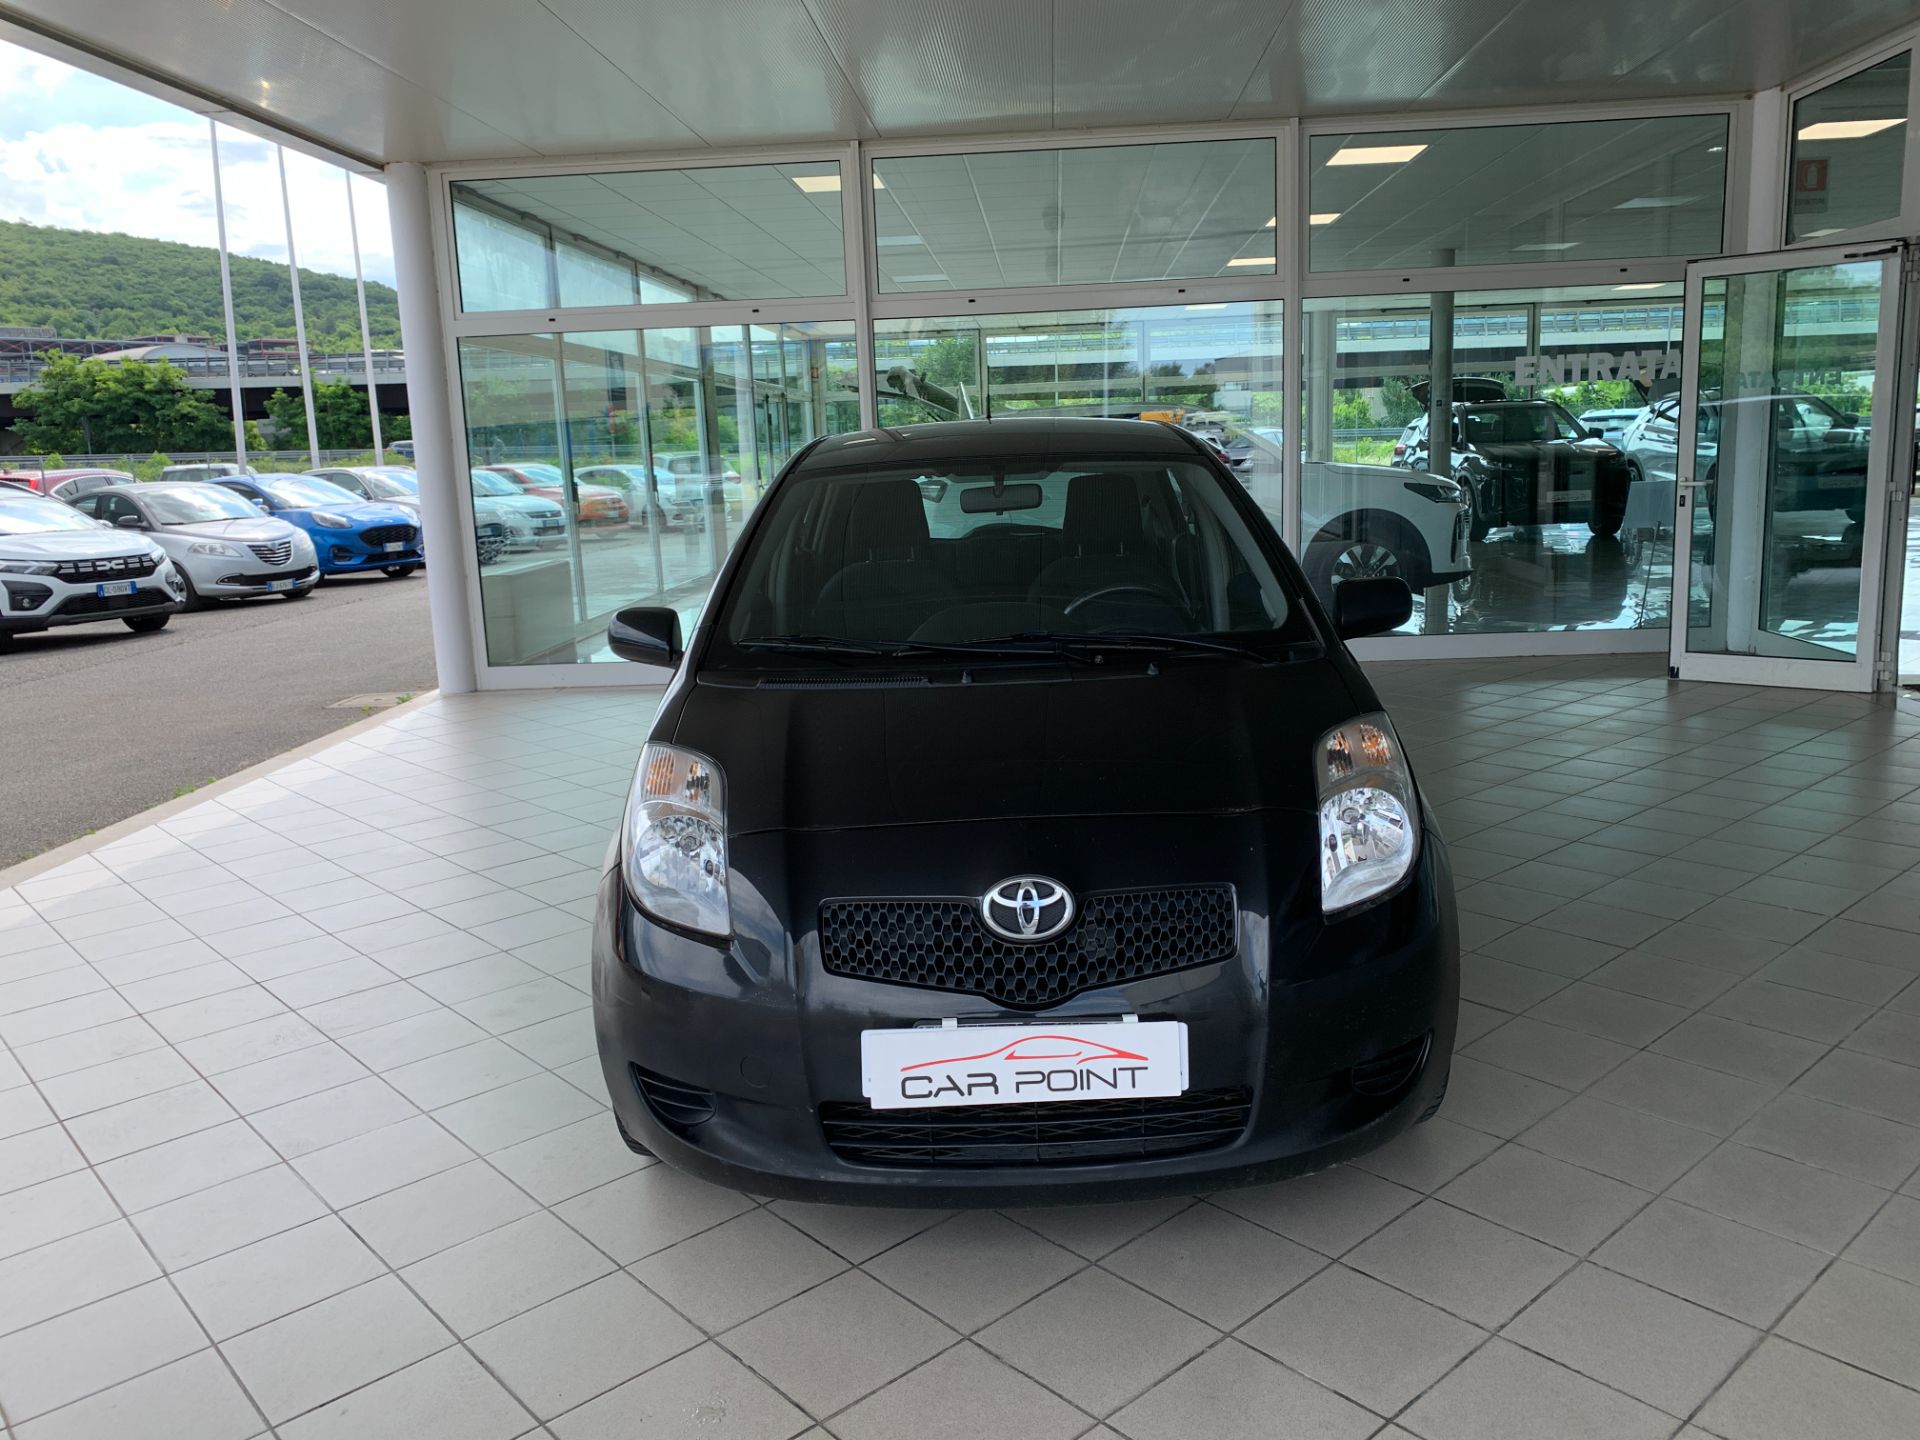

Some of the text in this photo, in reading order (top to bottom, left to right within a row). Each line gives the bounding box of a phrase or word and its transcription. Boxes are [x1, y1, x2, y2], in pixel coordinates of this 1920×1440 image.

[1515, 348, 1681, 386] ENTRATA
[901, 1067, 1148, 1099] CAR POINT
